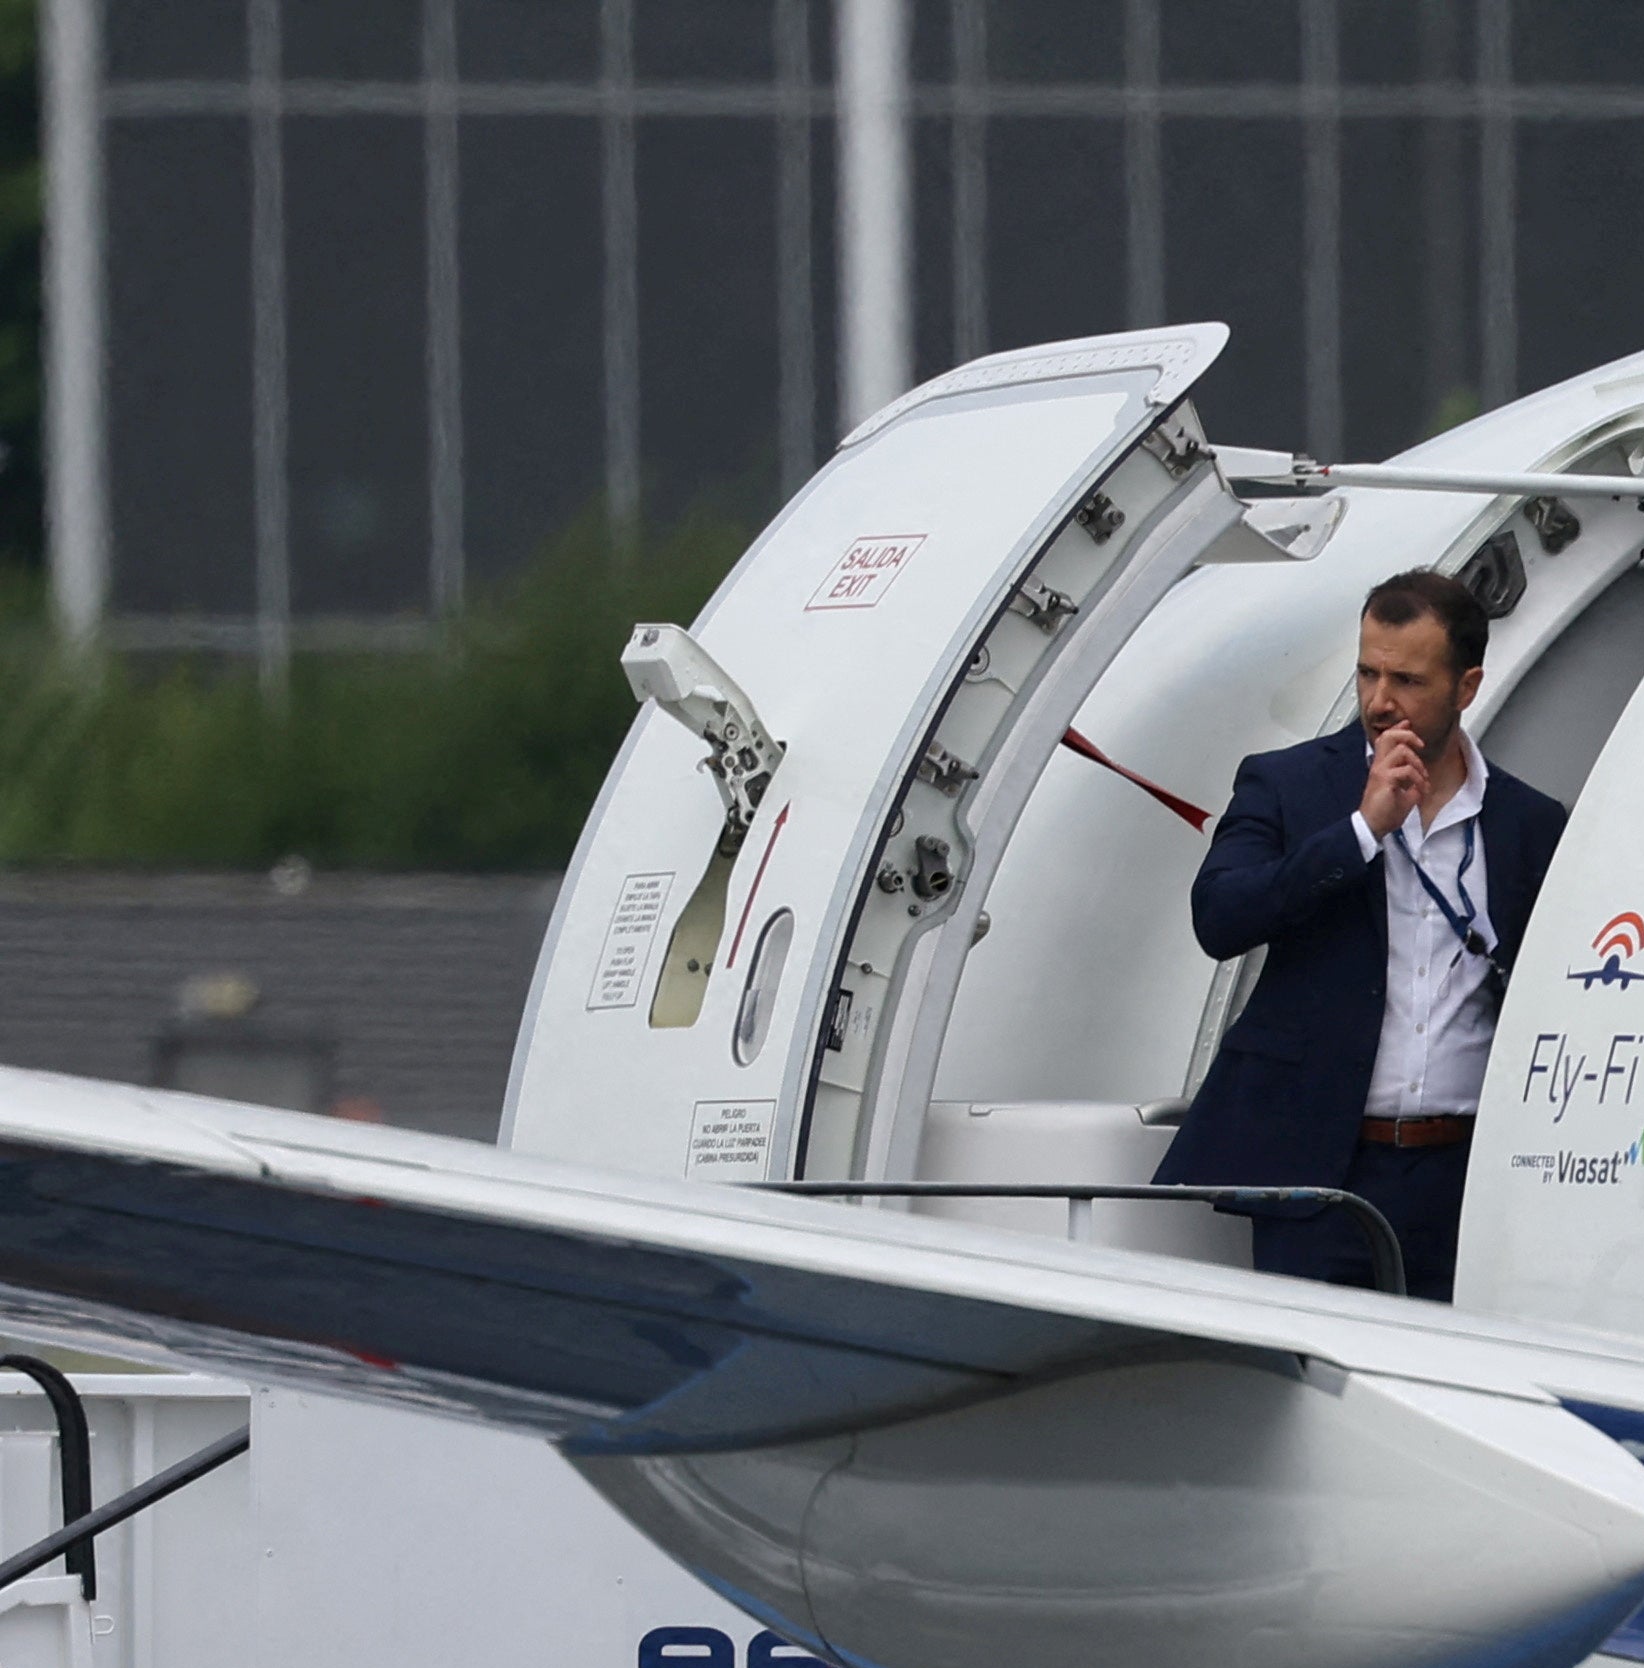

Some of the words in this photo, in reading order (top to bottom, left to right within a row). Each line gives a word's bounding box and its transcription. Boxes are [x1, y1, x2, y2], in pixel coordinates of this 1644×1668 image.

[841, 546, 908, 571] SALIDA
[828, 574, 878, 598] EXIT
[721, 1108, 747, 1119] PELIGRO
[1511, 1155, 1555, 1168] CONNECTED
[1558, 1150, 1621, 1184] Viasat
[1542, 1171, 1554, 1183] BY
